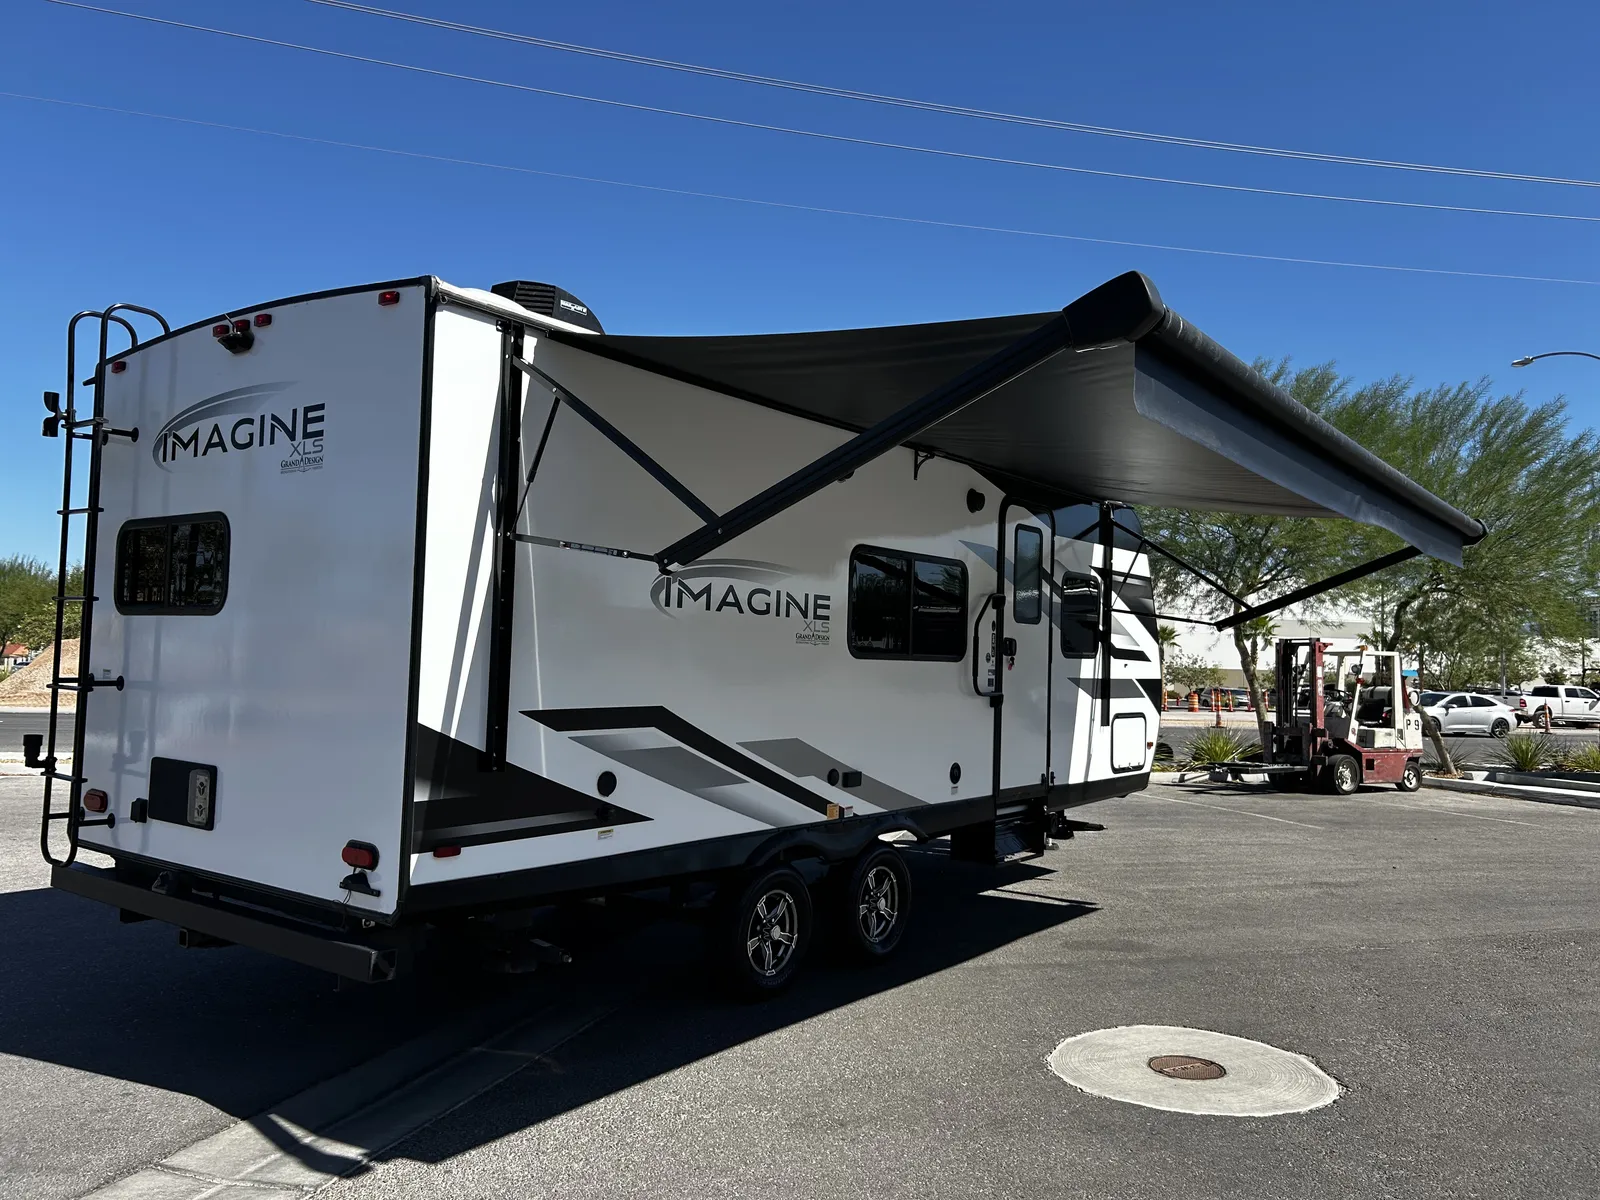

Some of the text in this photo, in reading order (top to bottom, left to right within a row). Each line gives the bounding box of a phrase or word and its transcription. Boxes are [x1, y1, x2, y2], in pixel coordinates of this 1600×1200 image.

[162, 402, 326, 463] IMAGINE
[289, 438, 324, 458] XLS
[664, 577, 831, 621] IMAGINE
[803, 620, 830, 633] XLS
